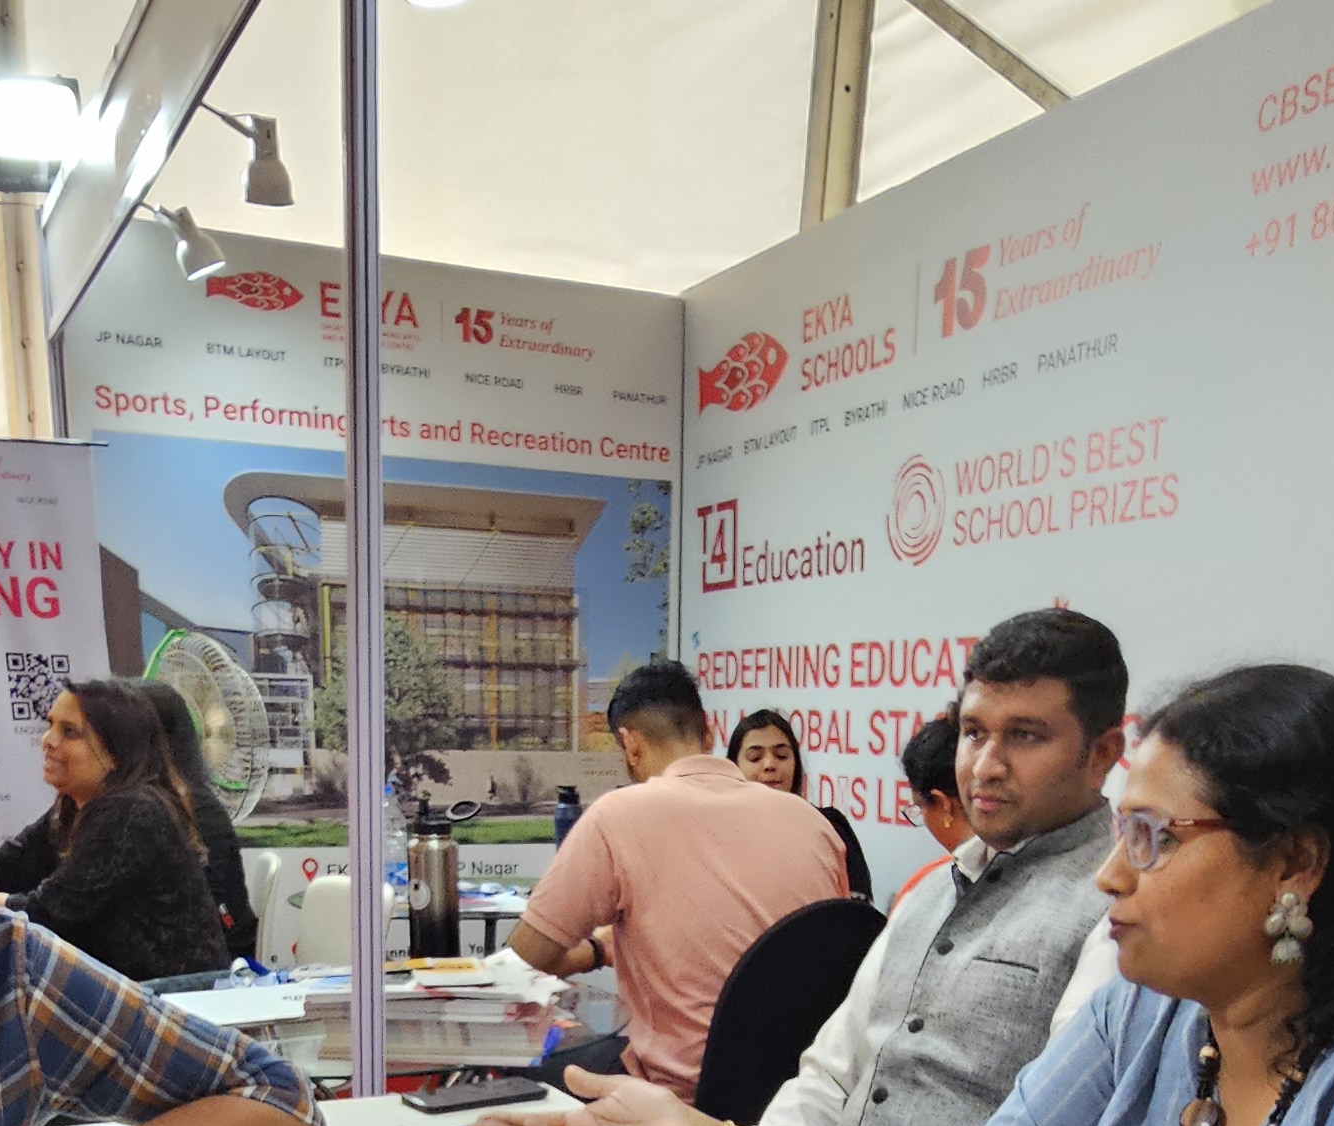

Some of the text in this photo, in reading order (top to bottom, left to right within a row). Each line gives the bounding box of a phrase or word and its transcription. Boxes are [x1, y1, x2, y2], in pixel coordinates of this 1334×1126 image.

[998, 202, 1091, 269] Years of
[1243, 212, 1299, 261] +91
[934, 243, 992, 340] 15
[993, 240, 1163, 323] Extraordinary
[95, 331, 111, 343] JP
[116, 333, 164, 349] NAGAR
[206, 342, 235, 356] BTM
[238, 345, 286, 362] LAYOUT
[455, 307, 496, 345] 15
[801, 294, 854, 344] EKYA
[800, 327, 897, 393] SCHOOLS
[931, 377, 966, 403] ROAD
[982, 362, 1019, 390] HRBR
[1037, 332, 1119, 375] PANATHUR
[94, 384, 195, 422] Sports,
[380, 415, 411, 439] rts
[419, 414, 463, 444] and
[470, 422, 593, 456] Recreation
[599, 436, 671, 463] Centre
[954, 417, 1168, 498] WORLD'S BEST
[952, 473, 1180, 550] SCHOOL PRIZES
[28, 540, 63, 572] IN
[742, 529, 866, 587] Education
[697, 643, 840, 691] REDEFINING
[471, 861, 519, 879] Nagar
